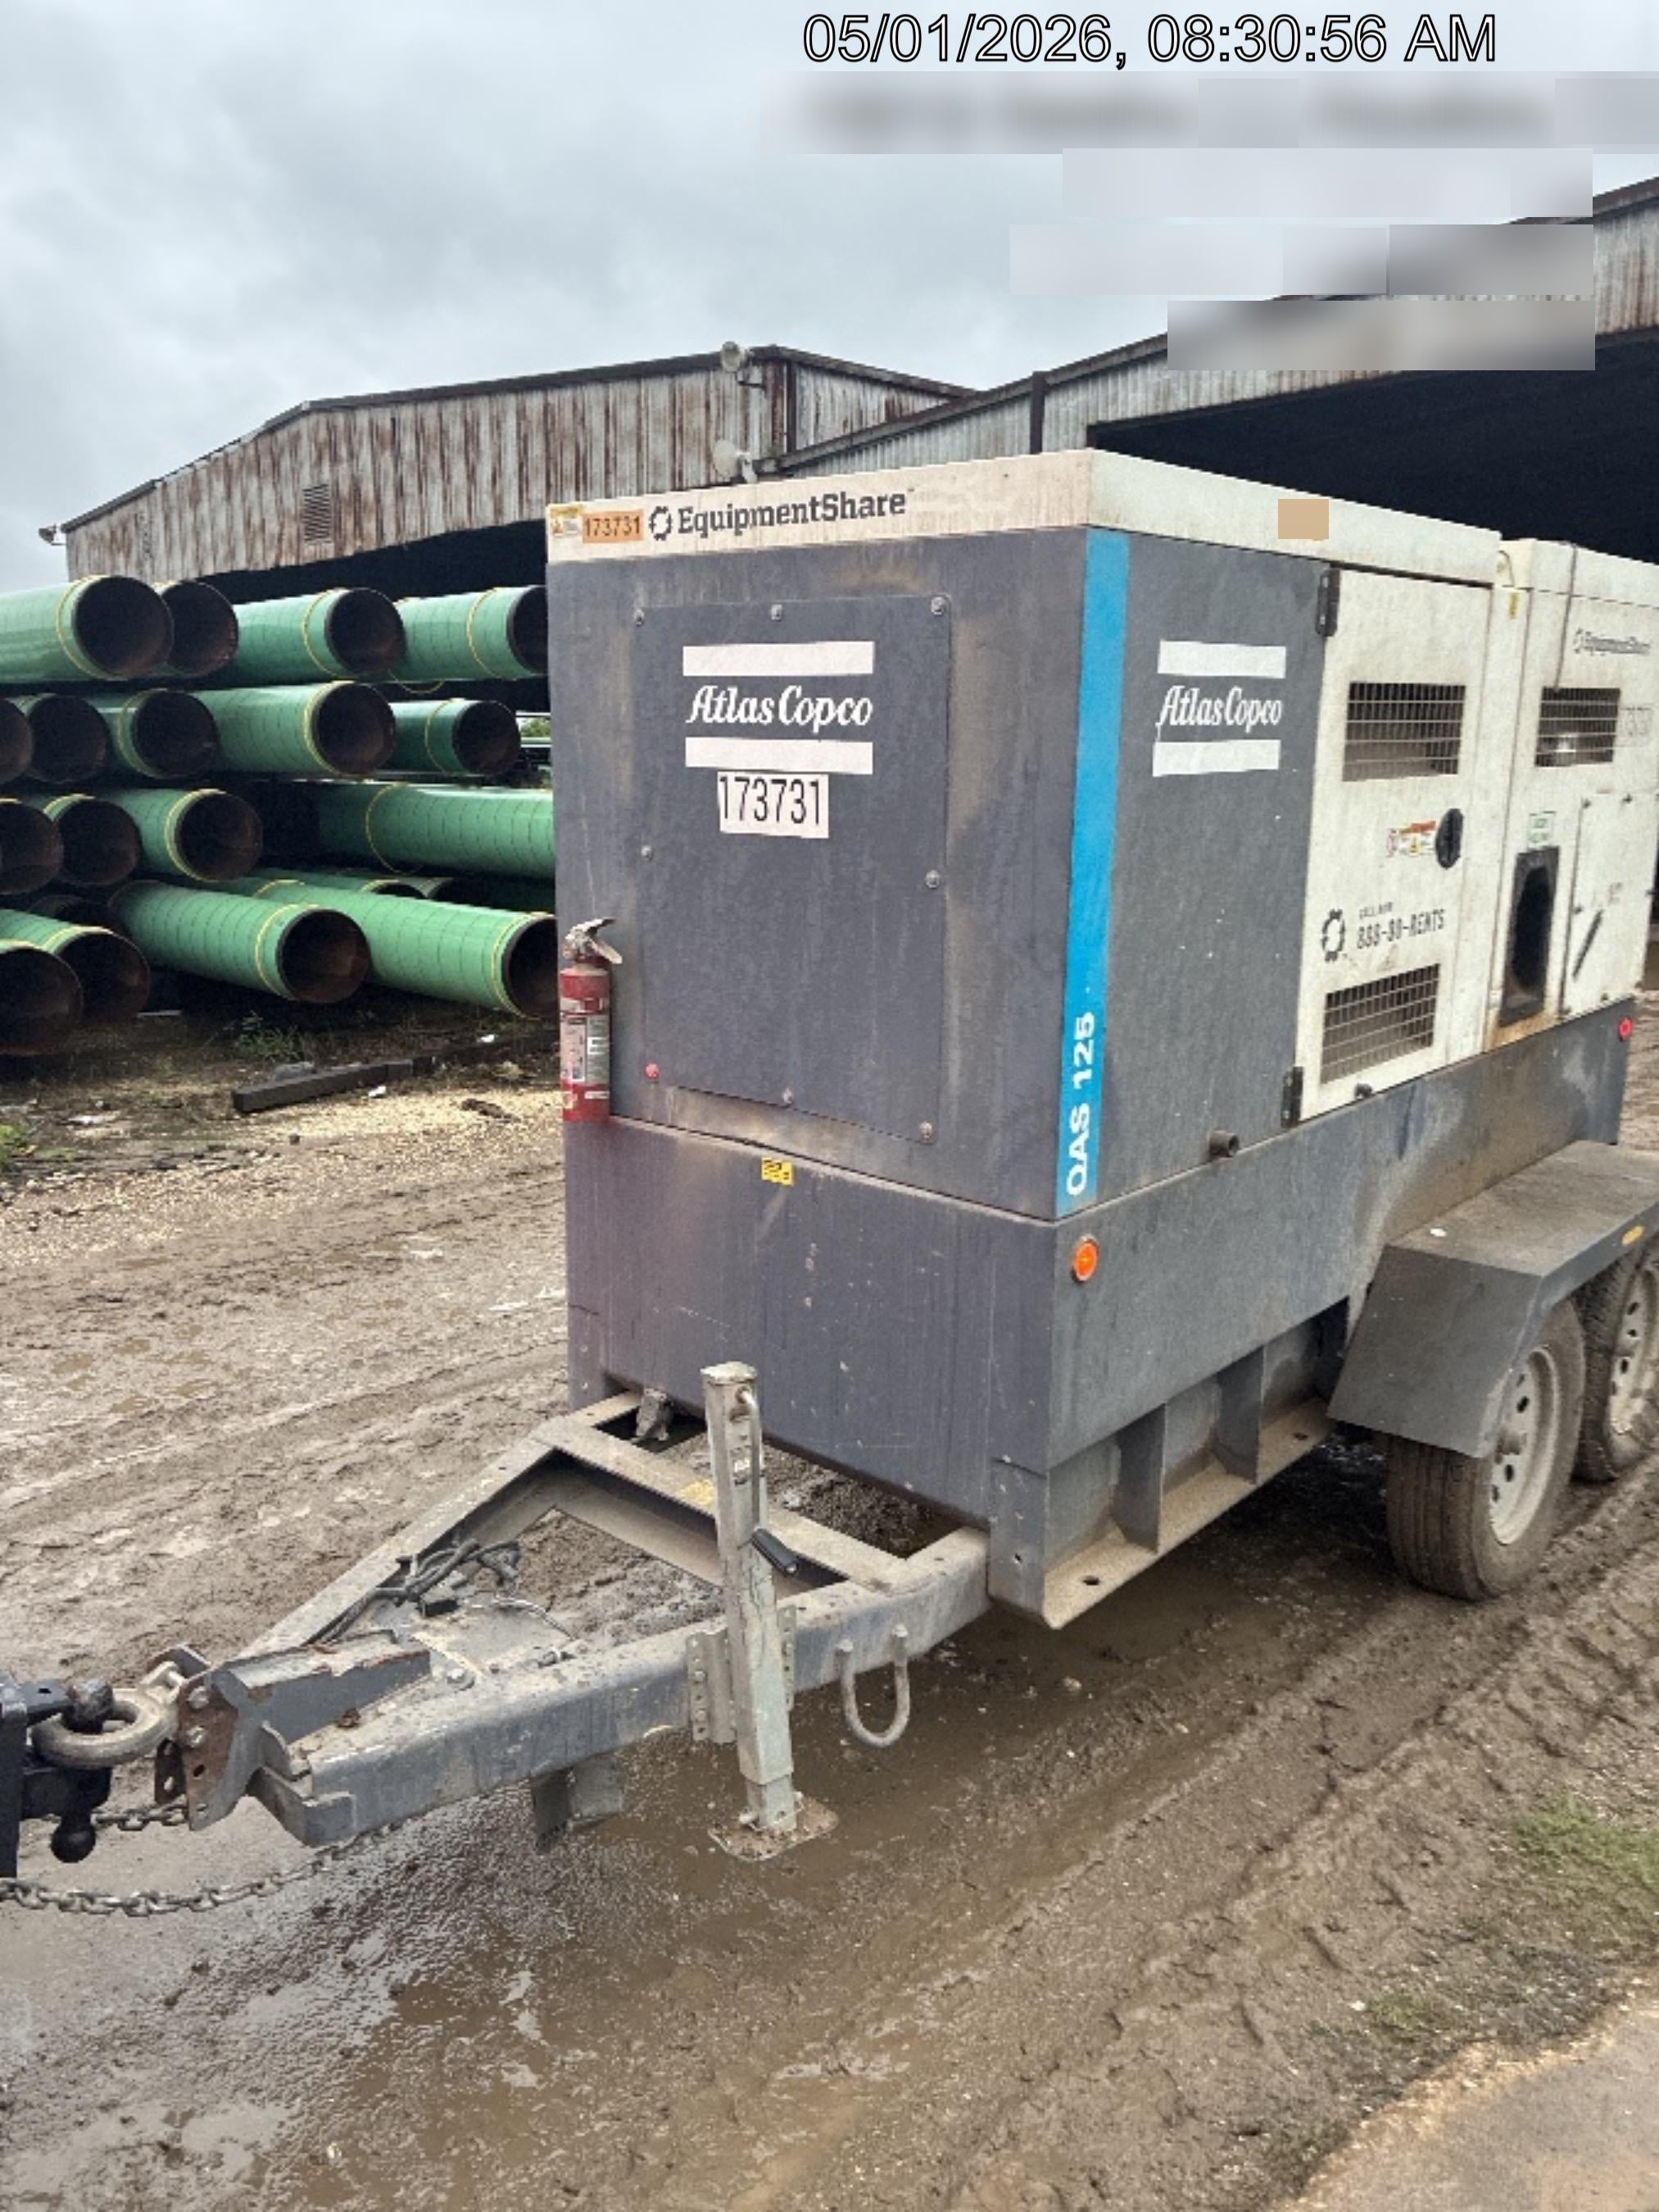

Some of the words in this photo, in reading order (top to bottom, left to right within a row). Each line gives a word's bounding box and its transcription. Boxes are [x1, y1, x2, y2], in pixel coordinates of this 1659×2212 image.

[584, 515, 641, 537] 173731
[678, 491, 906, 539] EquipmentShare
[685, 685, 775, 726] Atlas
[777, 685, 873, 734] Copco
[1154, 685, 1225, 726] Atlas
[1224, 685, 1284, 734] Copco
[719, 775, 820, 826] 173731
[1072, 1012, 1095, 1090] 125
